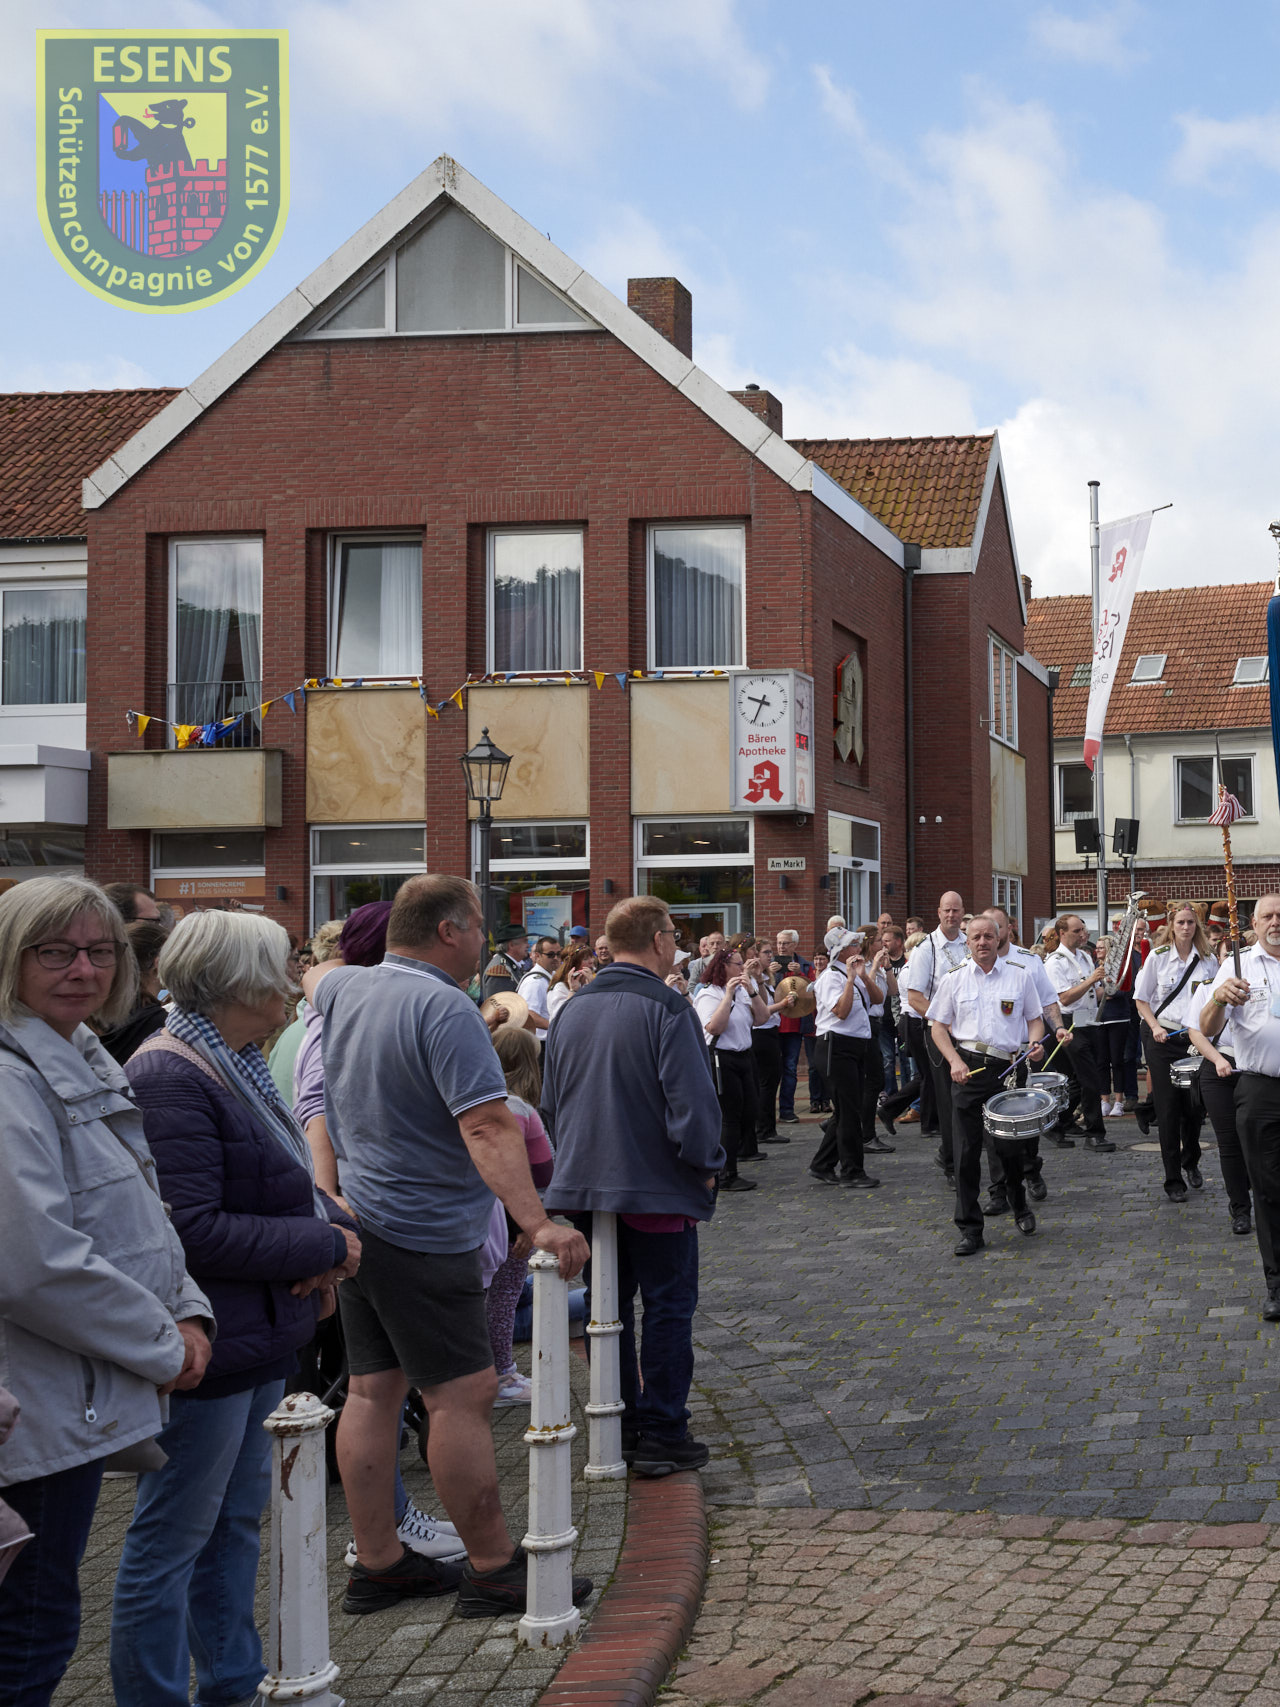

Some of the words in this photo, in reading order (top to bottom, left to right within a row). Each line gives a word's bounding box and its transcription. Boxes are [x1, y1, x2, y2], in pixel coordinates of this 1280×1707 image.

[747, 733, 777, 743] Bären
[738, 745, 787, 758] Apotheke
[770, 860, 782, 868] Am
[783, 860, 804, 868] Markt
[179, 882, 196, 895] #1
